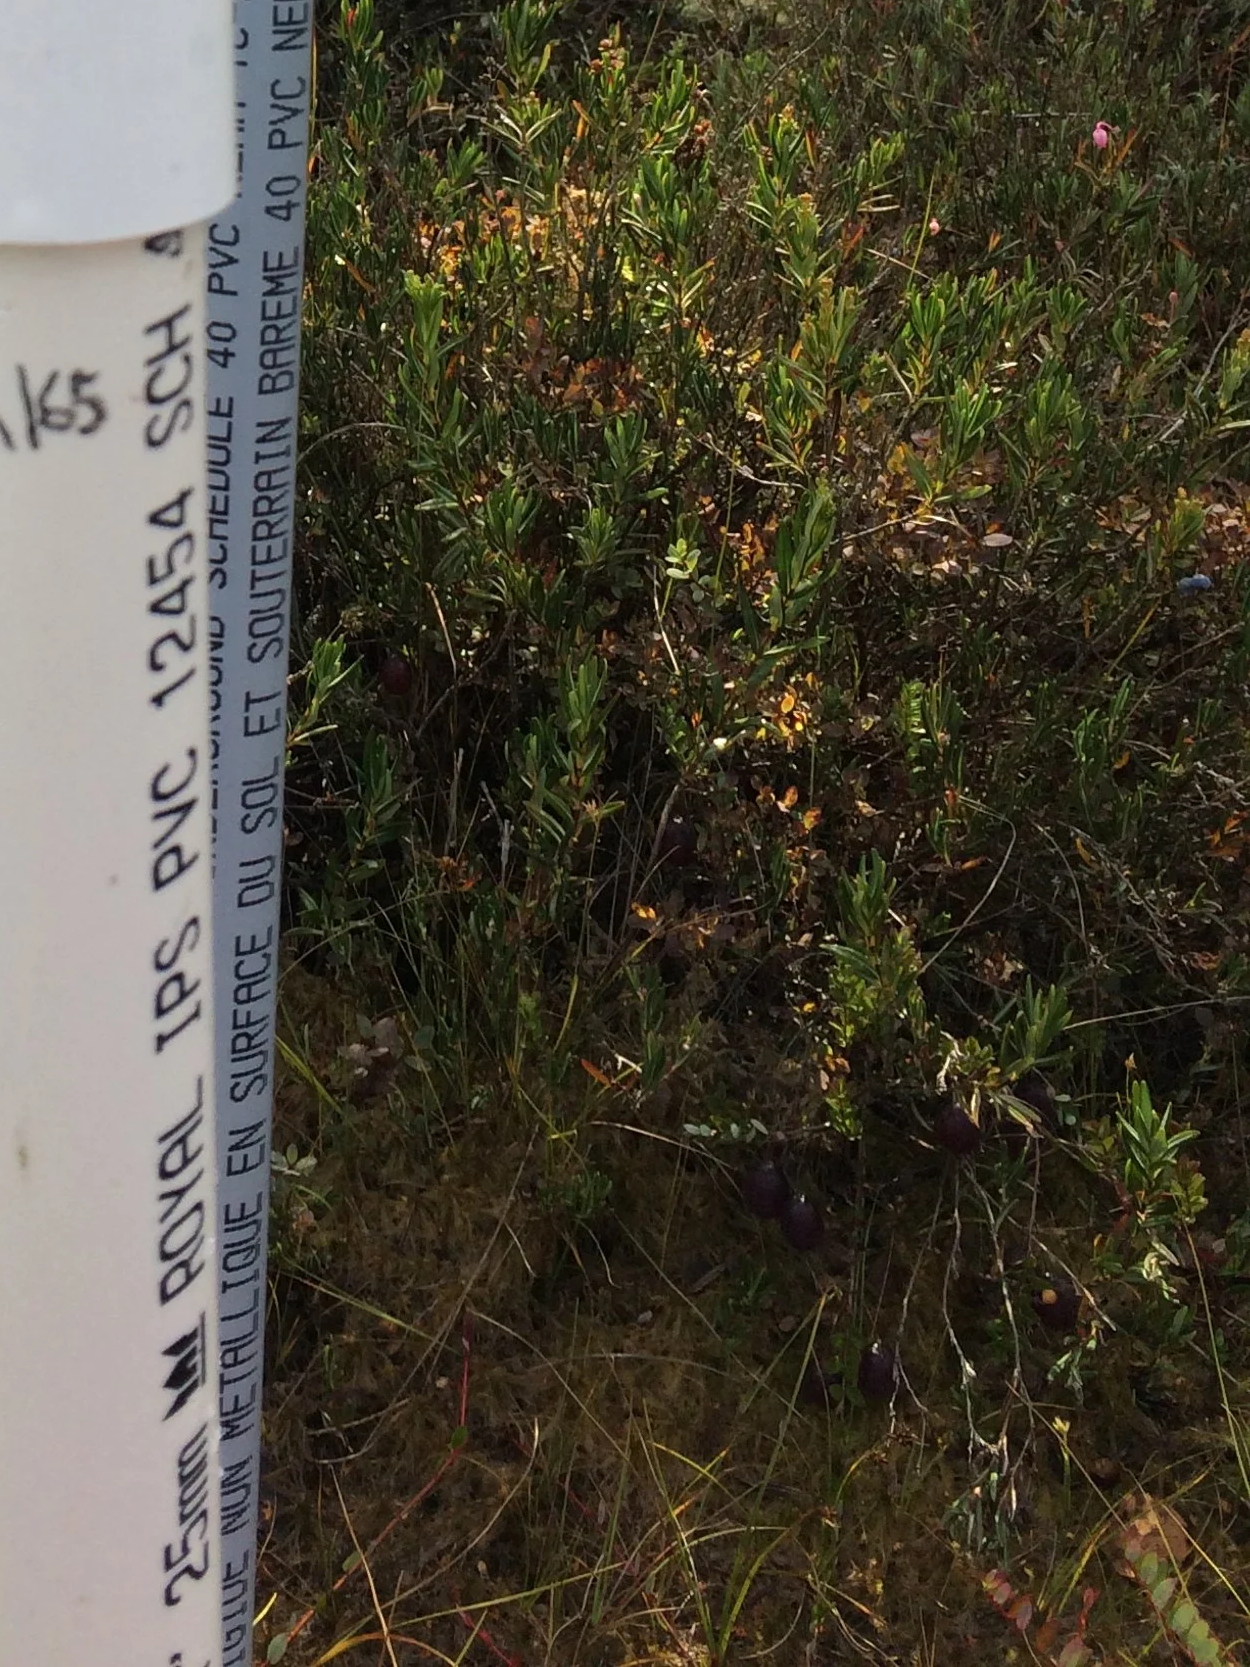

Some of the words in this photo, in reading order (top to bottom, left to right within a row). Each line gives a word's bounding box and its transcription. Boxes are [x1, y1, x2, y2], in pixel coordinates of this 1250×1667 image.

[267, 76, 307, 151] PVC
[207, 222, 240, 297] PVC
[264, 174, 301, 223] 40
[144, 301, 194, 450] SCH
[205, 320, 238, 370] 40
[257, 245, 300, 396] BAREME
[147, 485, 197, 711] 12454
[246, 415, 293, 665] SOUTERRAIN
[243, 690, 282, 738] ET
[150, 746, 199, 893] PVC
[240, 754, 280, 836] SOL
[236, 854, 277, 909] DU
[153, 915, 201, 1055] IPS
[229, 924, 274, 1104] SURFACE
[157, 1074, 204, 1306] ROYAL
[226, 1117, 267, 1177] EN
[218, 1190, 263, 1443] METALLIQUE
[162, 1421, 209, 1609] 25mm
